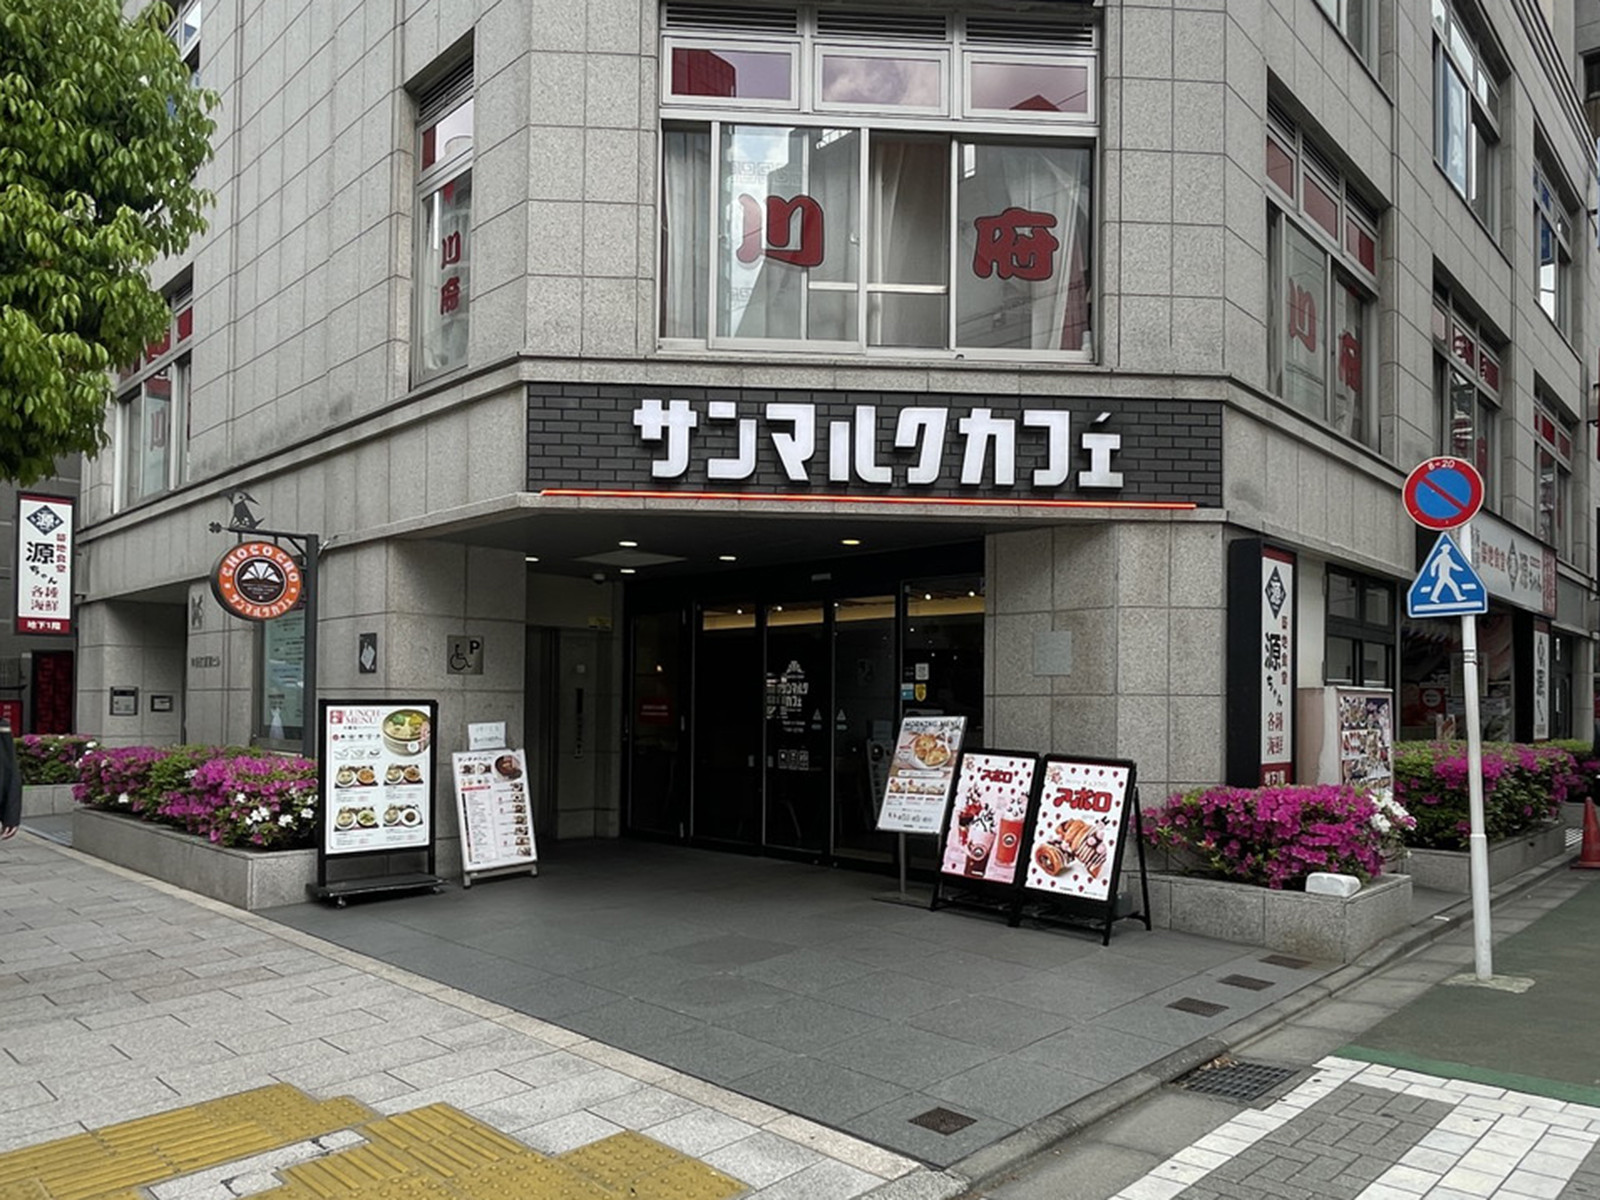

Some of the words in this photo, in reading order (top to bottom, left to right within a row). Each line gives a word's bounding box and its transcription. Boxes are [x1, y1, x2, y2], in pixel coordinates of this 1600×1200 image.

[633, 399, 1124, 489] サンマルクカフェ
[1428, 460, 1455, 470] 8-20
[470, 640, 480, 654] P
[1053, 787, 1114, 814] アポロ
